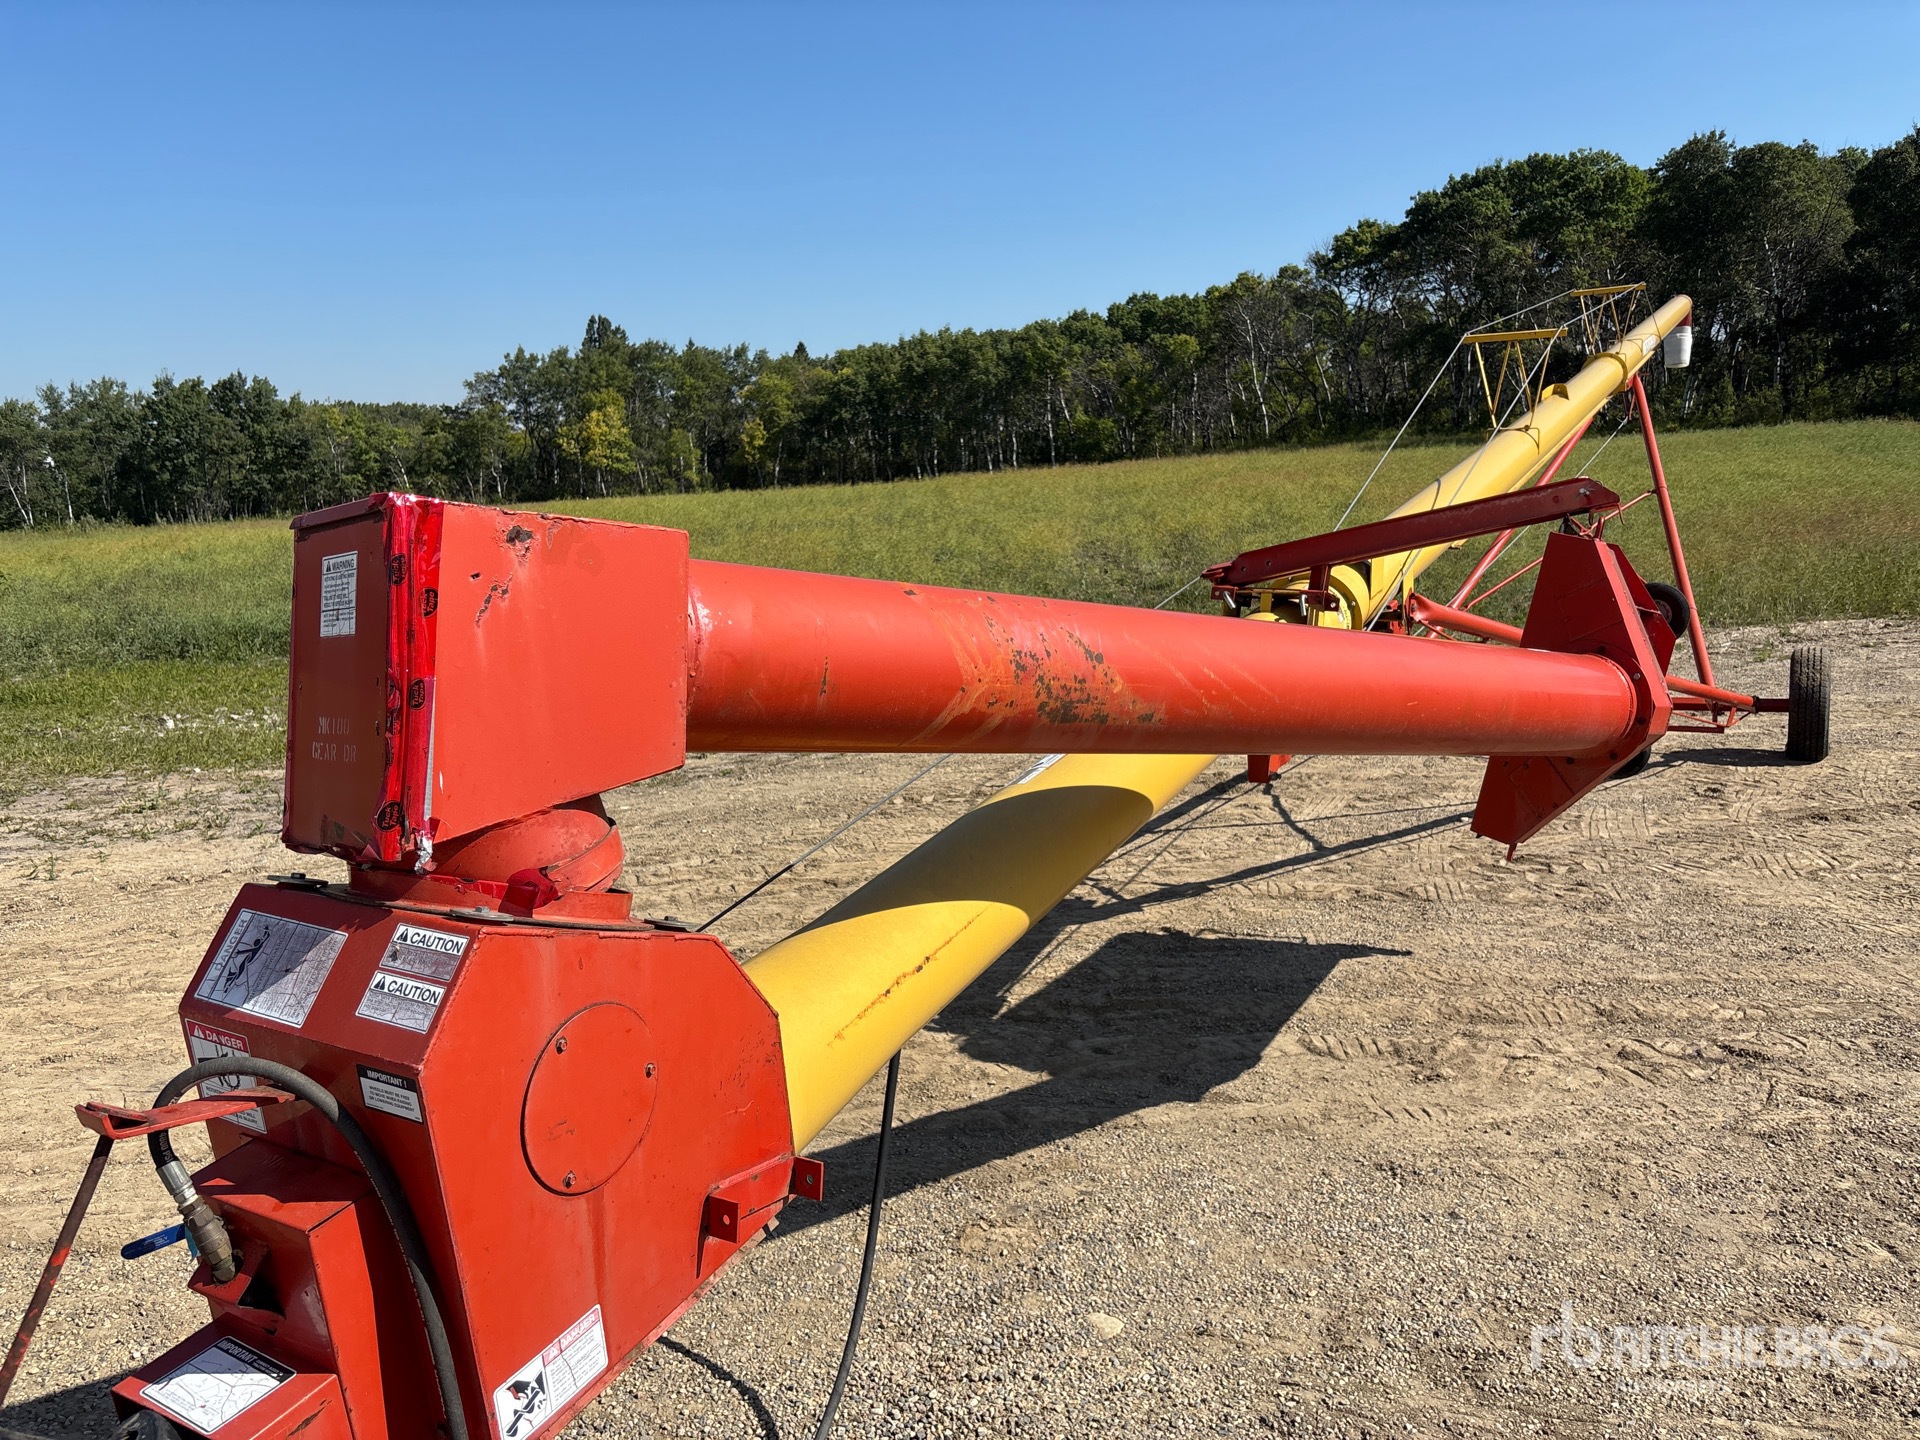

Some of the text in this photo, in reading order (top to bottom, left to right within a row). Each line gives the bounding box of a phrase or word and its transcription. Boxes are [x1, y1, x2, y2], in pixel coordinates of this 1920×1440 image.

[332, 559, 355, 572] WARNING
[312, 741, 357, 762] GEAR DR
[382, 807, 391, 827] Tuck
[390, 804, 399, 825] Tape
[215, 919, 248, 971] DANGER
[410, 932, 463, 954] CAUTION
[387, 981, 440, 1004] CAUTION
[206, 1031, 244, 1051] DANGER
[366, 1070, 403, 1087] IMPORTANT
[163, 1150, 174, 1163] PSI
[217, 1340, 258, 1364] IMPORTANT
